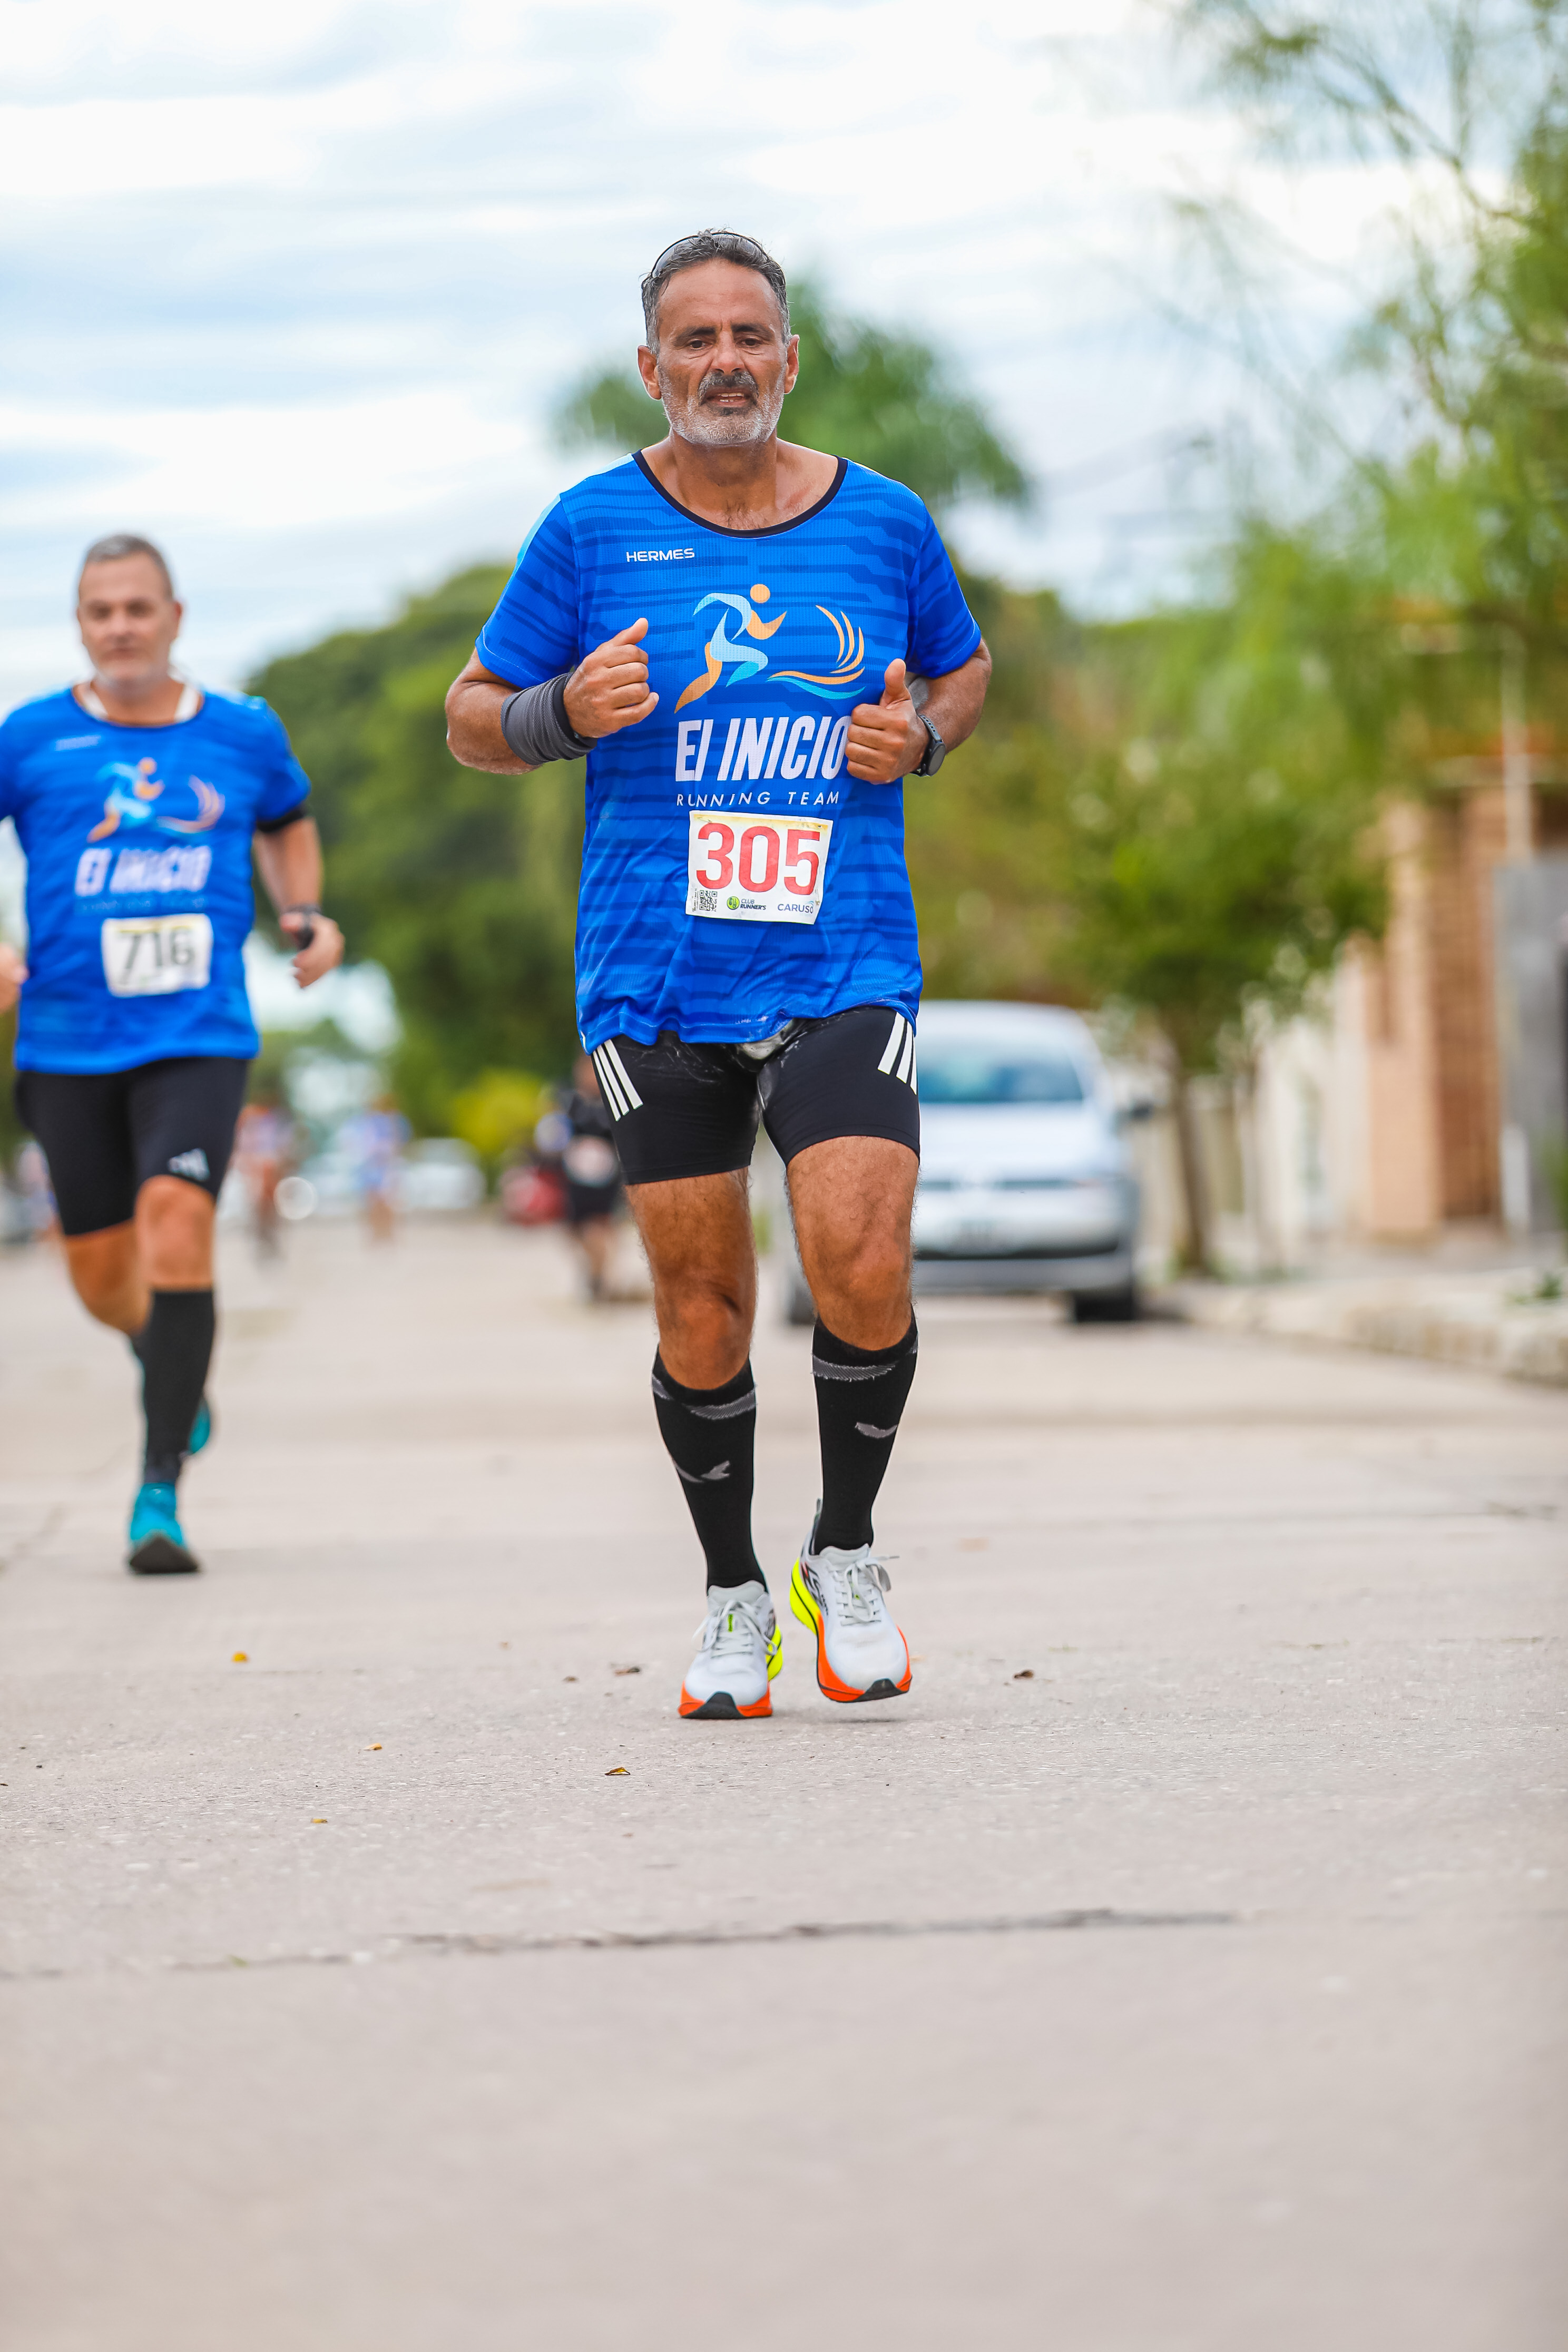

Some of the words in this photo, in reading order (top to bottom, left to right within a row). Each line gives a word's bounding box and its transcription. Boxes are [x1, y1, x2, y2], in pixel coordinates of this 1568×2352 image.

[626, 548, 694, 562] HERMES
[717, 715, 851, 780] INICIO
[677, 791, 770, 807] RUNNING
[788, 791, 839, 806] TEAM
[696, 822, 820, 895] 305
[778, 904, 814, 914] CARUSO
[117, 928, 195, 969] 716
